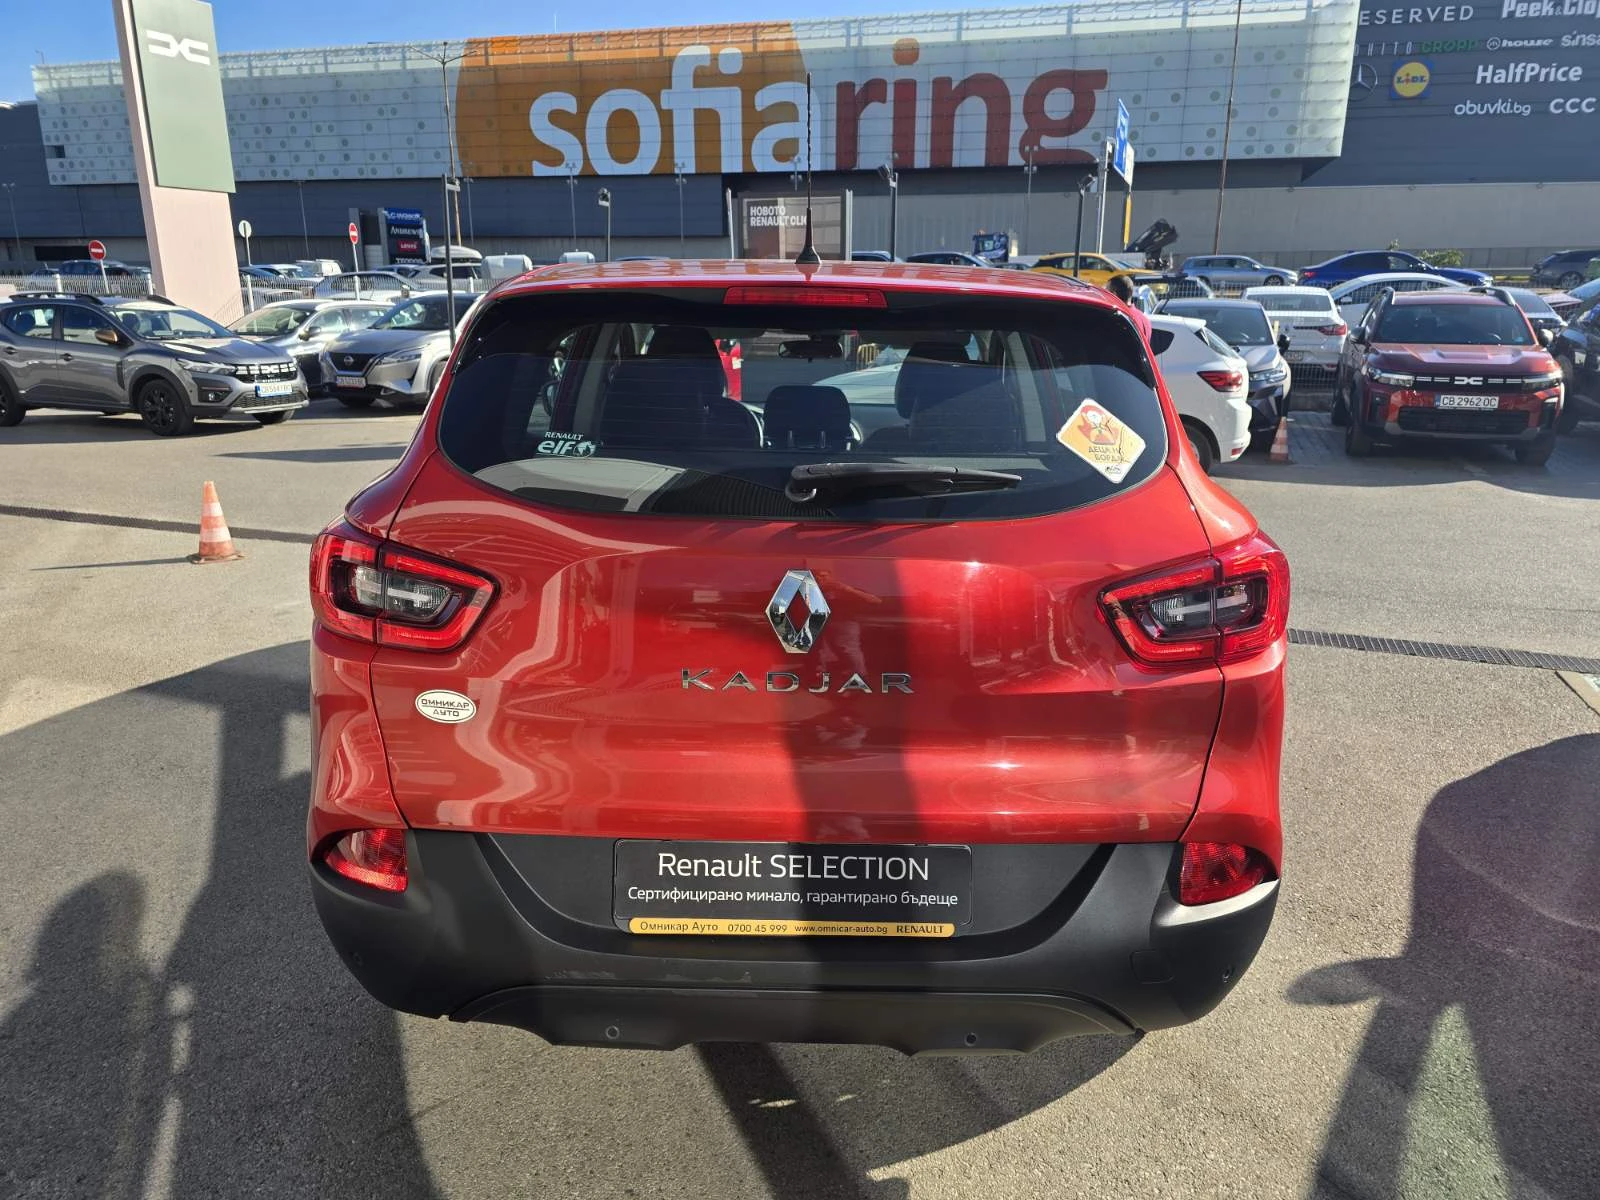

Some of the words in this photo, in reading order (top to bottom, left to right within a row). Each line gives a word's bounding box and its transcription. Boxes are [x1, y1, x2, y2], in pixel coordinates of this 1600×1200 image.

[1358, 5, 1474, 26] ESERVED
[1421, 39, 1478, 53] CROPP
[1475, 62, 1583, 84] HalfPrice
[1454, 98, 1531, 116] obuvki.bg
[1549, 97, 1597, 114] CCC
[750, 216, 789, 227] RENAULT
[544, 431, 584, 441] RENAULT
[537, 440, 576, 455] elf
[681, 668, 914, 694] KADJAR
[421, 698, 470, 709] ОМНИКАР
[433, 708, 460, 717] АУТО
[658, 853, 762, 879] Renault
[770, 854, 929, 881] SELECTION
[628, 887, 743, 903] Сертифицирано
[746, 890, 803, 904] минало,
[807, 891, 898, 907] гарантирано
[901, 891, 958, 907] бъдеще
[640, 921, 689, 932] Омникар
[692, 921, 718, 932] Ауто
[727, 924, 752, 933] 0700
[754, 924, 767, 933] 45
[769, 924, 788, 933] 999
[794, 923, 888, 935] www.omnicar-auto.bg
[896, 925, 945, 934] RENAULT
